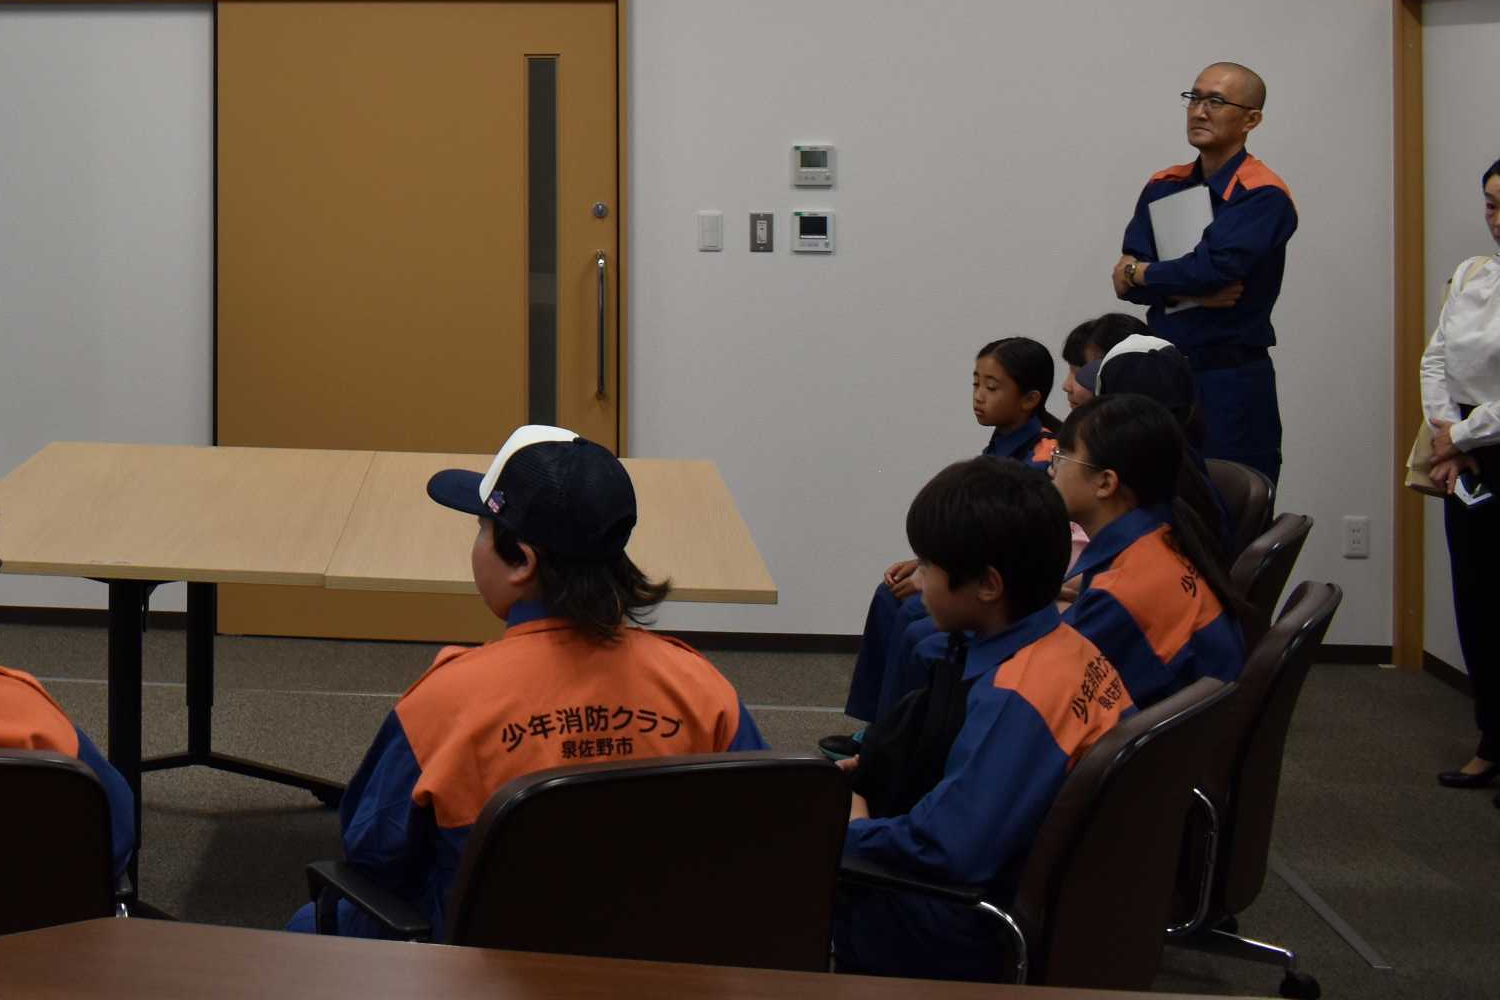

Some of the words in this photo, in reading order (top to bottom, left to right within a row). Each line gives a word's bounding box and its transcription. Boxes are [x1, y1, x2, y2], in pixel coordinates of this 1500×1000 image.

[501, 705, 684, 753] 少年消防クラブ
[561, 736, 634, 759] 泉佐野市
